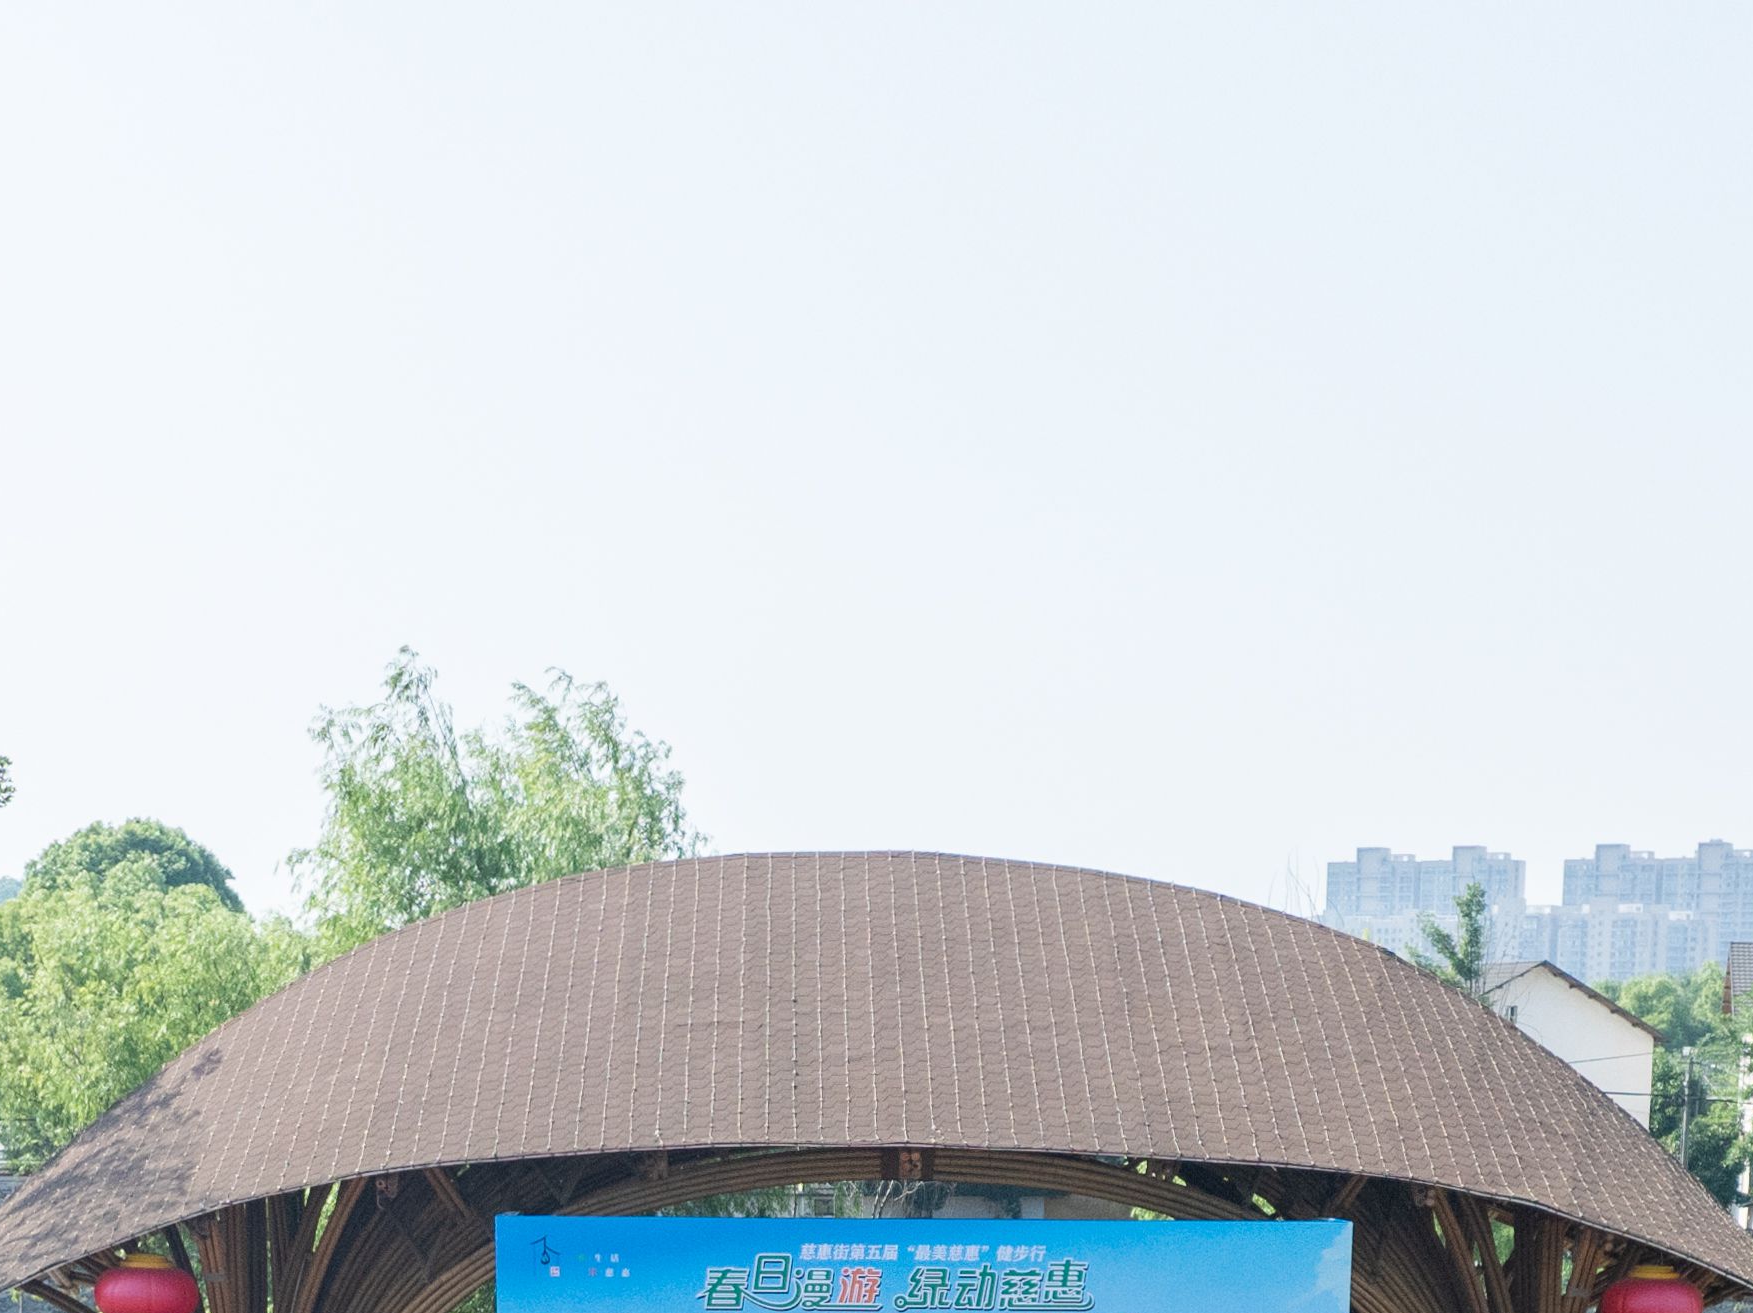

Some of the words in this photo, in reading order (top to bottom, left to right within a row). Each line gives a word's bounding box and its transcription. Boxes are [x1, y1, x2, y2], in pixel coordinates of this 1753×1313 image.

[696, 1252, 883, 1312] 春日漫游
[894, 1258, 1095, 1312] 绿动慈惠
